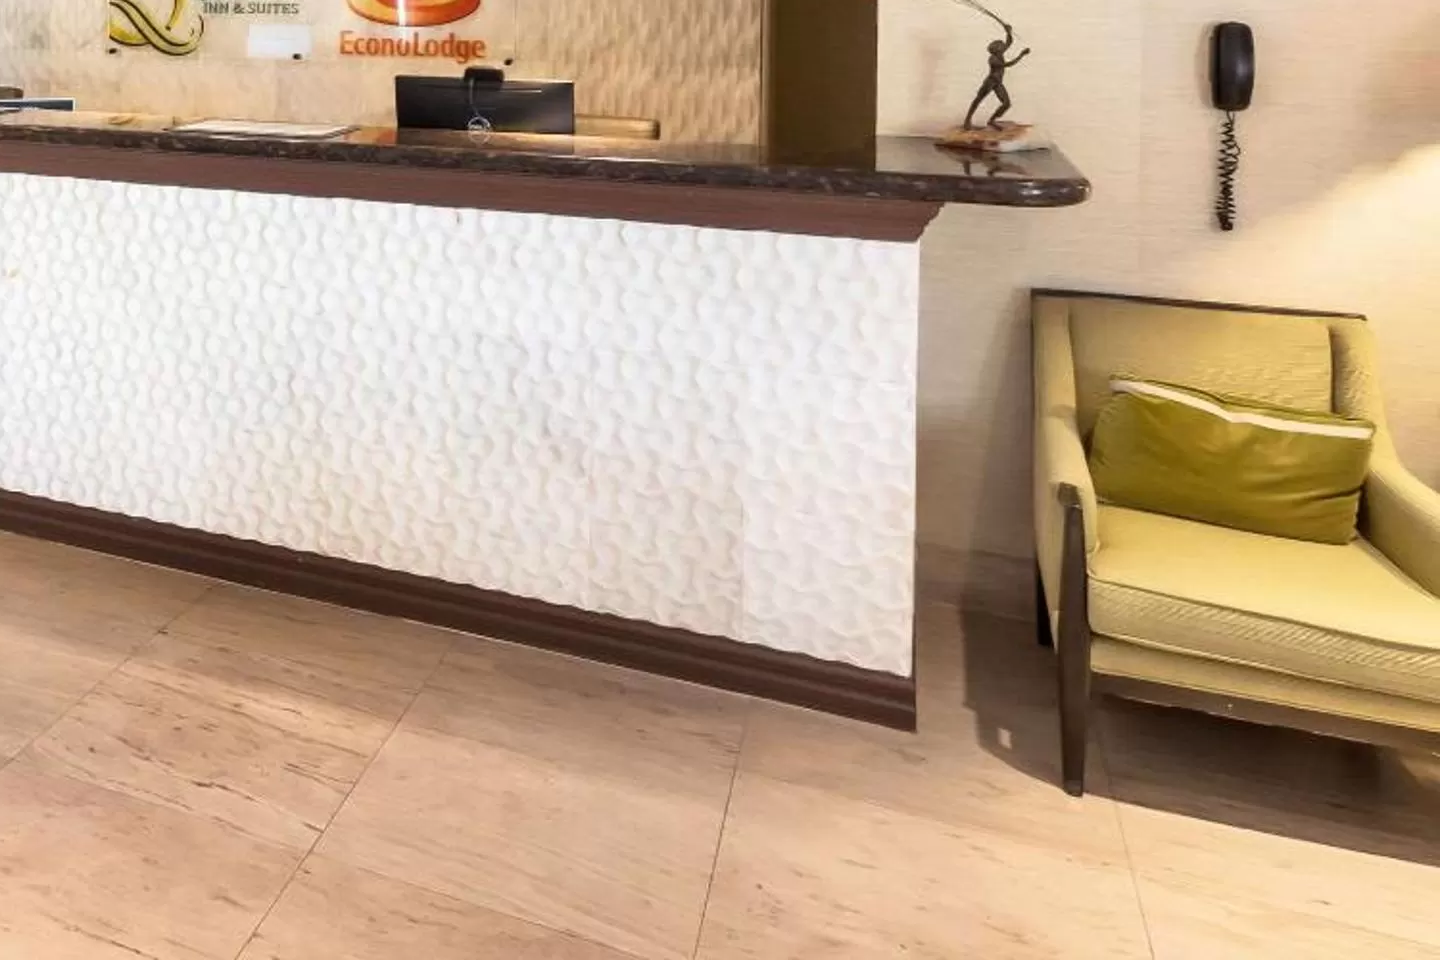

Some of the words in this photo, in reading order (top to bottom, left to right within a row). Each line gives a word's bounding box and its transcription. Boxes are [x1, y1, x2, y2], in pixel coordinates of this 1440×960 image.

[203, 2, 229, 14] INN
[233, 3, 246, 14] &
[247, 2, 299, 14] SUITES
